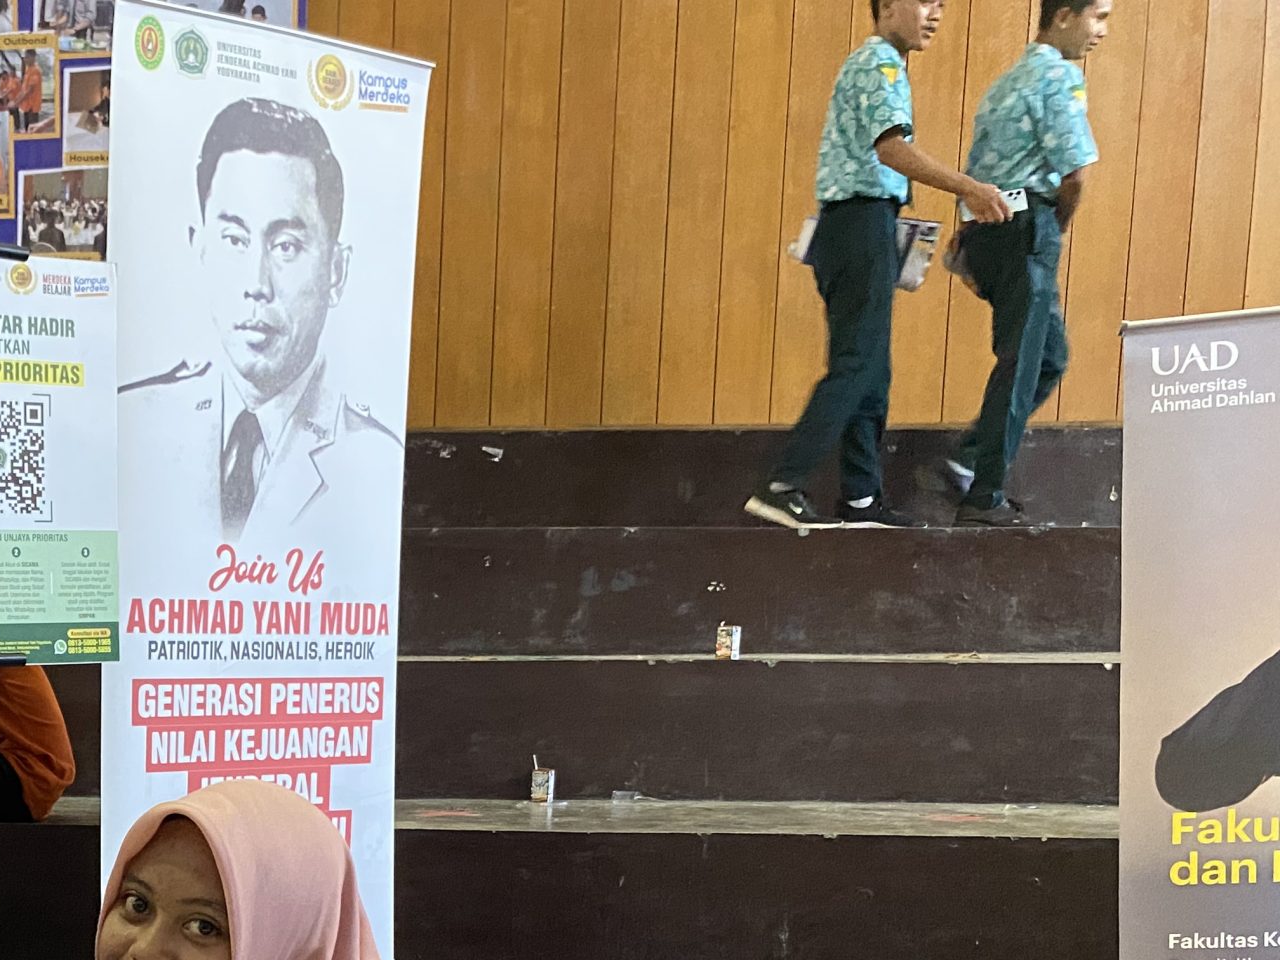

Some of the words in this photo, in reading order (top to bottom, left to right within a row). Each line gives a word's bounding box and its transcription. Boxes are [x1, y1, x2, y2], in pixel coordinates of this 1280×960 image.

[3, 36, 48, 46] Outbond
[217, 41, 262, 59] UNIVERSITAS
[359, 70, 407, 90] Kampus
[358, 87, 410, 104] Merdeka
[42, 273, 72, 285] MERDEKA
[74, 275, 107, 286] Kampus
[74, 284, 109, 293] Merdeka
[42, 284, 72, 296] BELAJAR
[28, 316, 75, 338] HADIR
[1151, 340, 1239, 376] UAD
[1151, 377, 1248, 398] Universitas
[1151, 394, 1213, 414] Ahmad
[1216, 390, 1276, 408] Dahlan
[4, 533, 31, 542] UNJAYA
[32, 533, 69, 542] PRIORITAS
[208, 544, 279, 592] Join
[285, 547, 325, 596] Us
[126, 598, 244, 635] ACHMAD
[253, 601, 311, 636] YANI
[320, 602, 390, 636] MUDA
[148, 640, 227, 662] PATRIOTIK,
[230, 641, 323, 662] NASIONALIS,
[325, 641, 376, 661] HEROIK
[137, 682, 262, 719] GENERASI
[270, 681, 381, 716] PENERUS
[151, 729, 217, 765] NILAI
[224, 725, 369, 762] KEJUANGAN
[1170, 851, 1258, 886] dan
[1168, 932, 1259, 949] Fakultas
